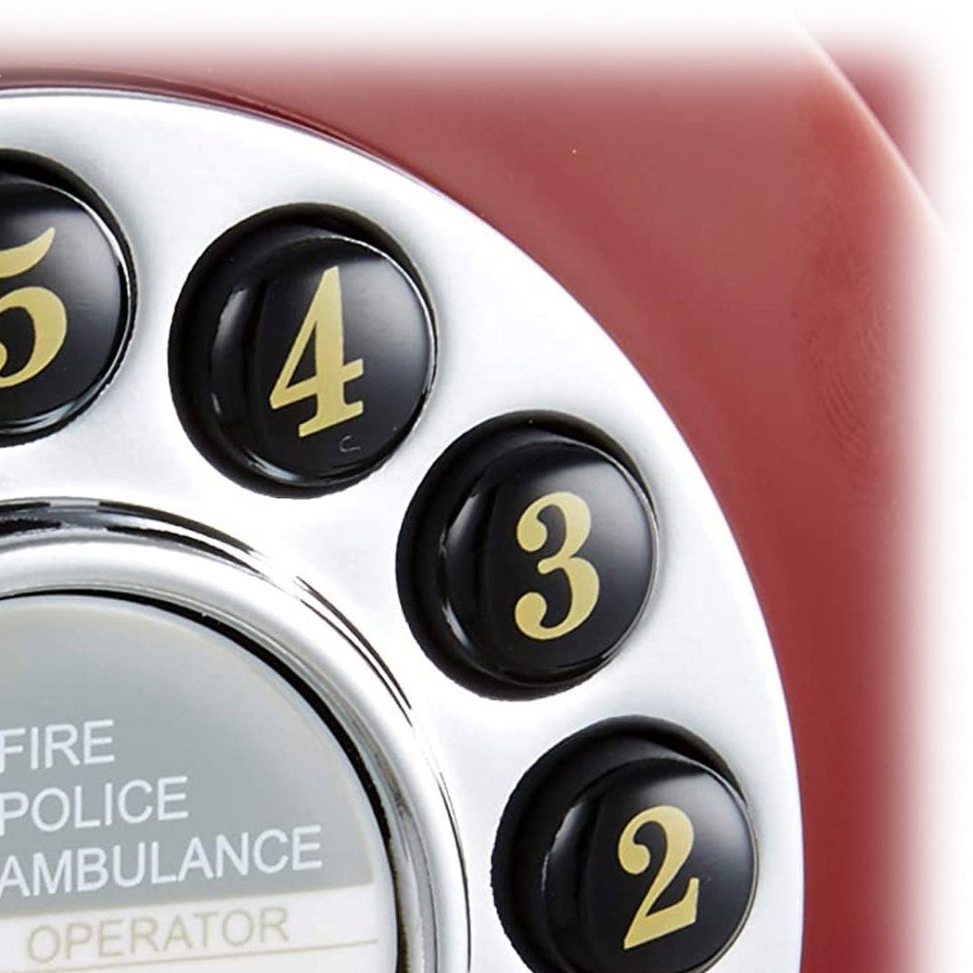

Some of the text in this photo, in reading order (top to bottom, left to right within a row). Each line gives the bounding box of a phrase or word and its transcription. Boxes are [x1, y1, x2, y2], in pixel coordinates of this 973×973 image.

[269, 267, 363, 438] 4
[514, 491, 599, 641] 3
[26, 906, 290, 965] OPERATOR
[617, 806, 699, 950] 2
